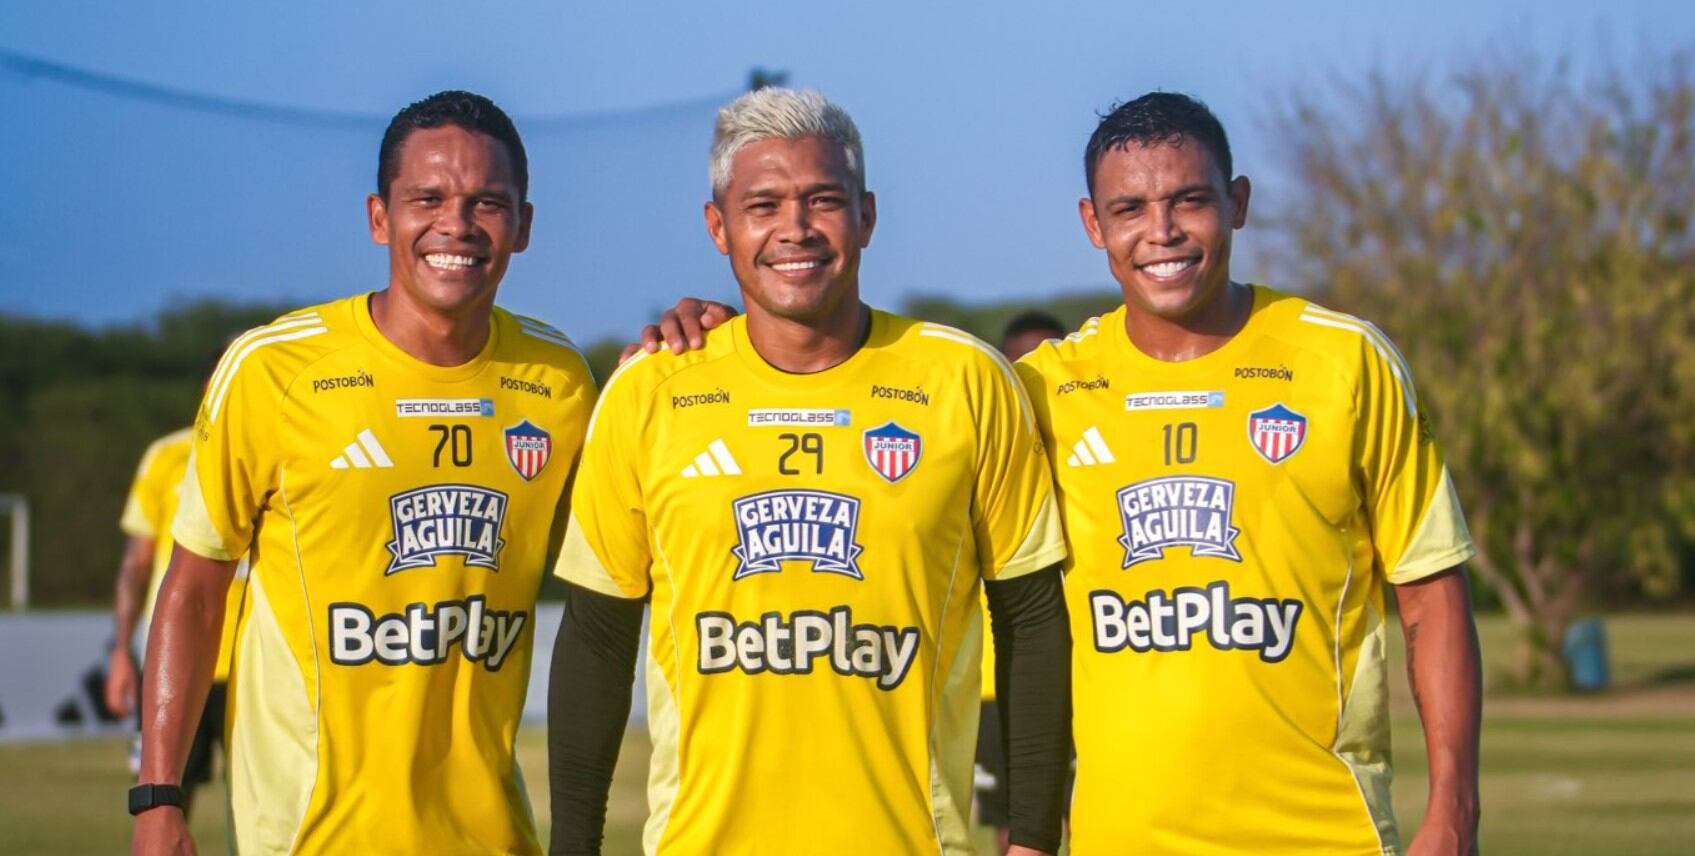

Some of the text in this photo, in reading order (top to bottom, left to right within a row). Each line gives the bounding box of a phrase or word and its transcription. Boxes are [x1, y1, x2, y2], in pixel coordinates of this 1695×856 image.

[428, 424, 473, 468] 70
[513, 440, 545, 450] JUNIOR
[873, 442, 913, 451] JUNIOR
[1162, 422, 1198, 466] 10
[1257, 424, 1297, 433] JUNIOR
[778, 432, 824, 476] 29
[402, 517, 493, 556] AGUILA
[747, 522, 846, 561] AGUILA
[1130, 508, 1223, 549] AGUILA
[331, 597, 526, 669] BetPlay
[1090, 583, 1301, 661] BetPlay
[698, 608, 919, 688] BetPlay
